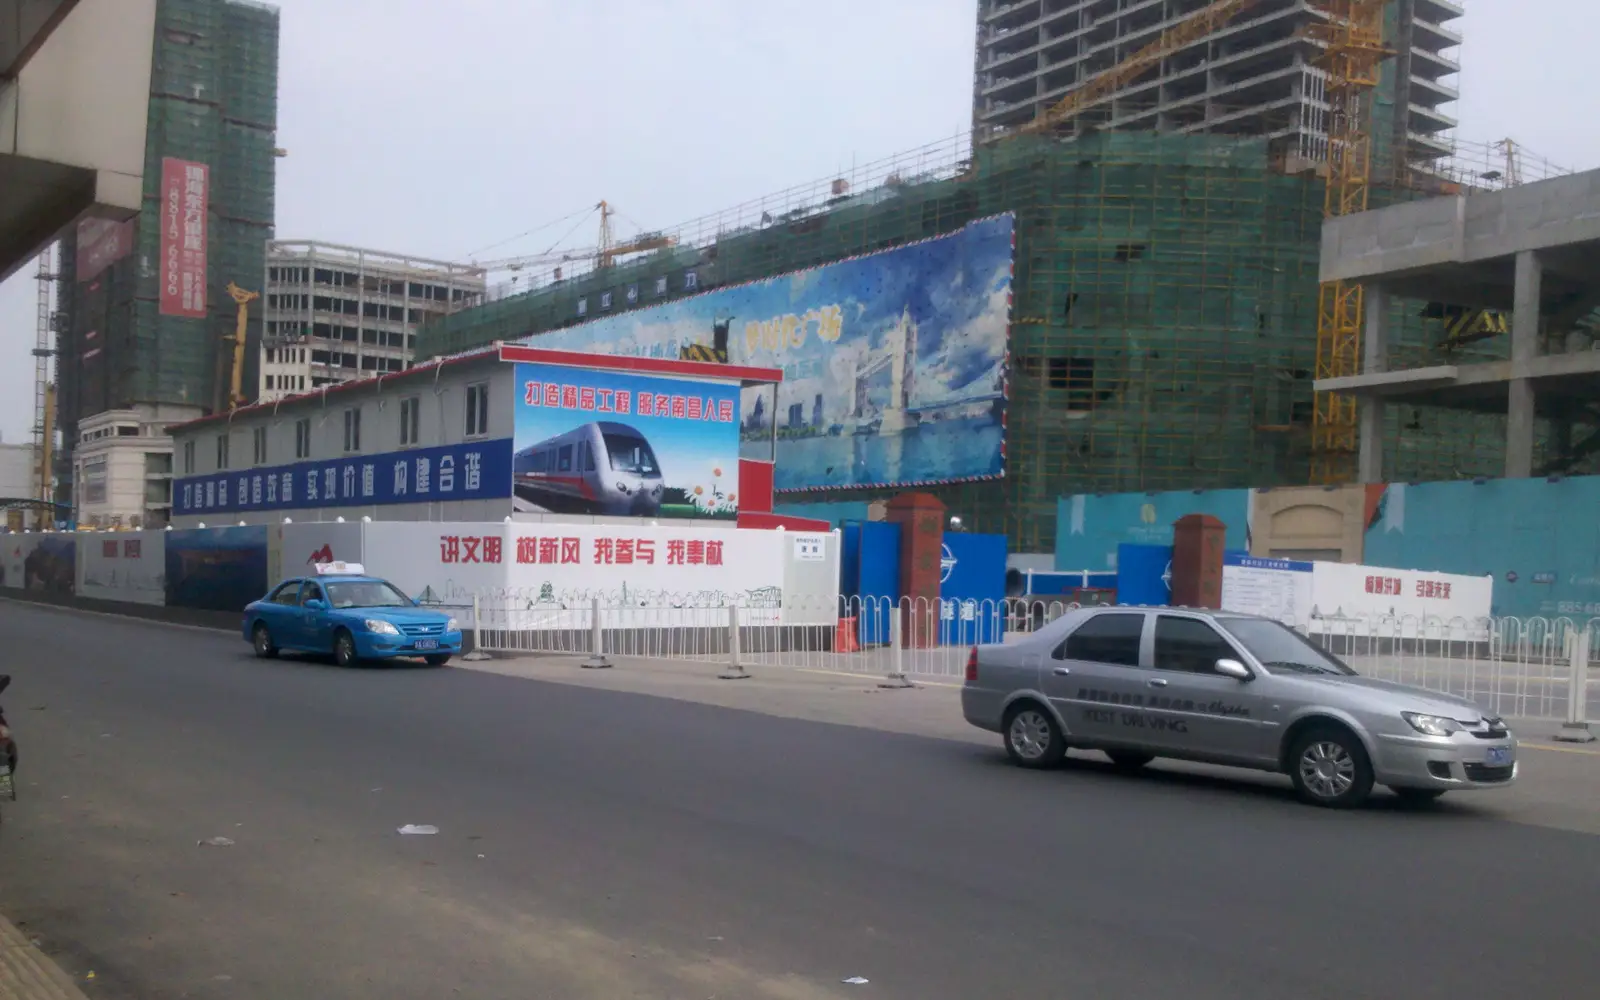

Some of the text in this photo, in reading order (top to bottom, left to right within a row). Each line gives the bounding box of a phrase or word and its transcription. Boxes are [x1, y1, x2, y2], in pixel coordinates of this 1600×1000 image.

[524, 380, 734, 422] 打造精品工程 服务南昌人民
[238, 471, 293, 505] 创造效益
[307, 463, 375, 500] 实现价值
[393, 452, 482, 496] 构建合谐
[440, 535, 724, 566] 讲文明 树新风 我参与 我奉献
